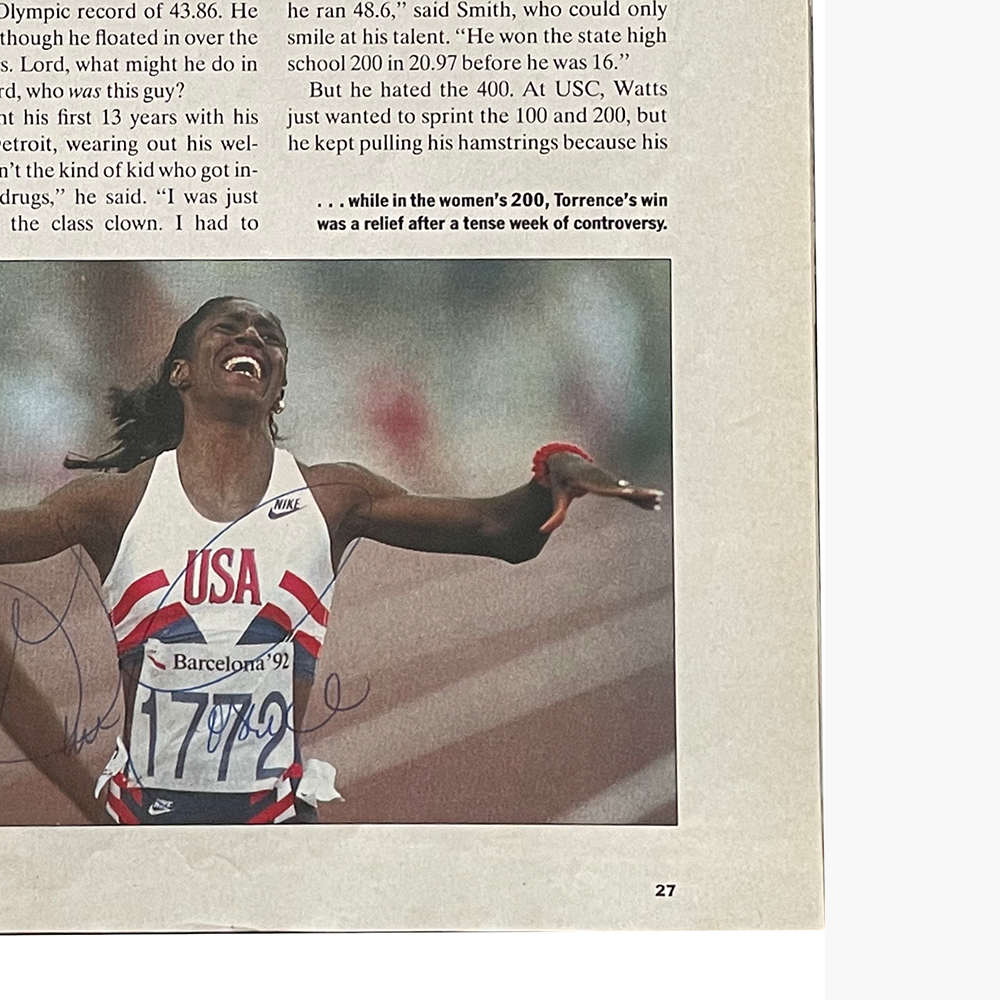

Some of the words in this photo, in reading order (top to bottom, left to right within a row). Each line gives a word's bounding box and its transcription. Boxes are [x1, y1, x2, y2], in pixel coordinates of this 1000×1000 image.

[78, 3, 136, 19] record
[144, 2, 164, 19] of
[170, 2, 222, 19] 43.86.
[231, 3, 258, 18] He
[310, 82, 342, 98] But
[351, 81, 372, 97] he
[381, 81, 431, 97] hated
[440, 81, 468, 97] the
[477, 81, 513, 97] 400.
[522, 81, 545, 97] At
[555, 80, 604, 100] USC,
[613, 80, 667, 96] Watts
[66, 135, 138, 156] wearing
[147, 138, 177, 151] out
[187, 135, 212, 151] his
[221, 135, 258, 151] wel-
[348, 193, 389, 207] while
[391, 193, 407, 207] in
[410, 193, 435, 207] the
[439, 192, 507, 207] women's
[511, 193, 549, 210] 200,
[554, 192, 637, 207] Torrence's
[641, 192, 667, 207] win
[11, 215, 39, 231] the
[52, 215, 93, 231] class
[105, 215, 162, 231] clown.
[176, 215, 182, 230] I
[196, 214, 227, 230] had
[241, 217, 258, 230] to
[317, 220, 346, 230] was
[351, 220, 359, 230] a
[365, 216, 404, 230] relief
[408, 216, 445, 230] after
[450, 220, 459, 230] a
[463, 216, 505, 230] tense
[509, 215, 549, 230] week
[553, 215, 569, 230] of
[574, 216, 667, 232] controversy.
[273, 497, 301, 511] NIKE
[184, 547, 262, 606] USA
[141, 690, 288, 782] 1772
[655, 884, 676, 897] 27
